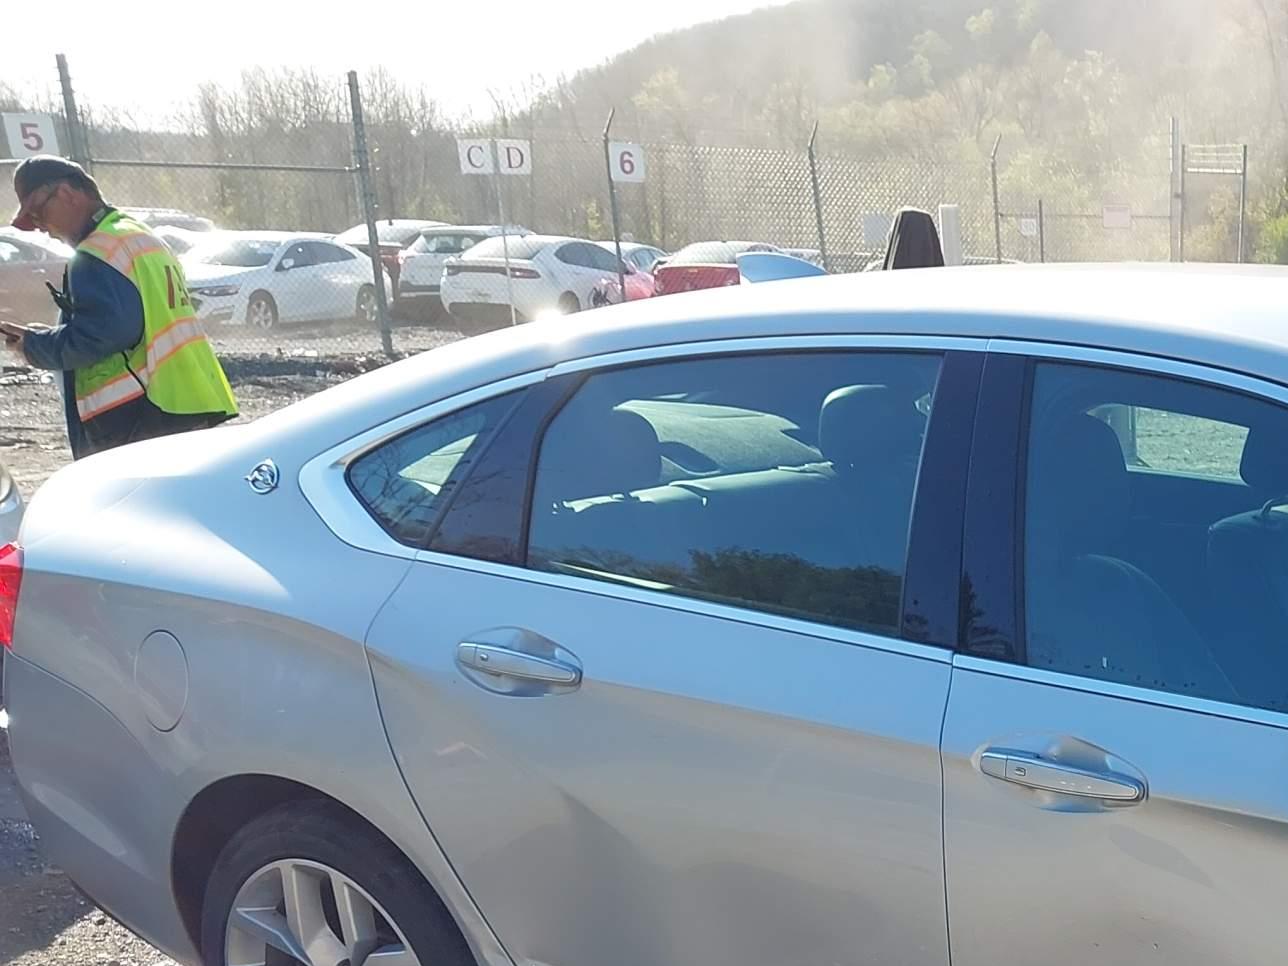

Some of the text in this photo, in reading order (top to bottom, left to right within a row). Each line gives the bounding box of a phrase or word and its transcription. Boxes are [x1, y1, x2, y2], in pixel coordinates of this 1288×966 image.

[20, 122, 44, 152] 5
[466, 145, 485, 169] C
[506, 146, 525, 169] D
[619, 150, 636, 175] 6
